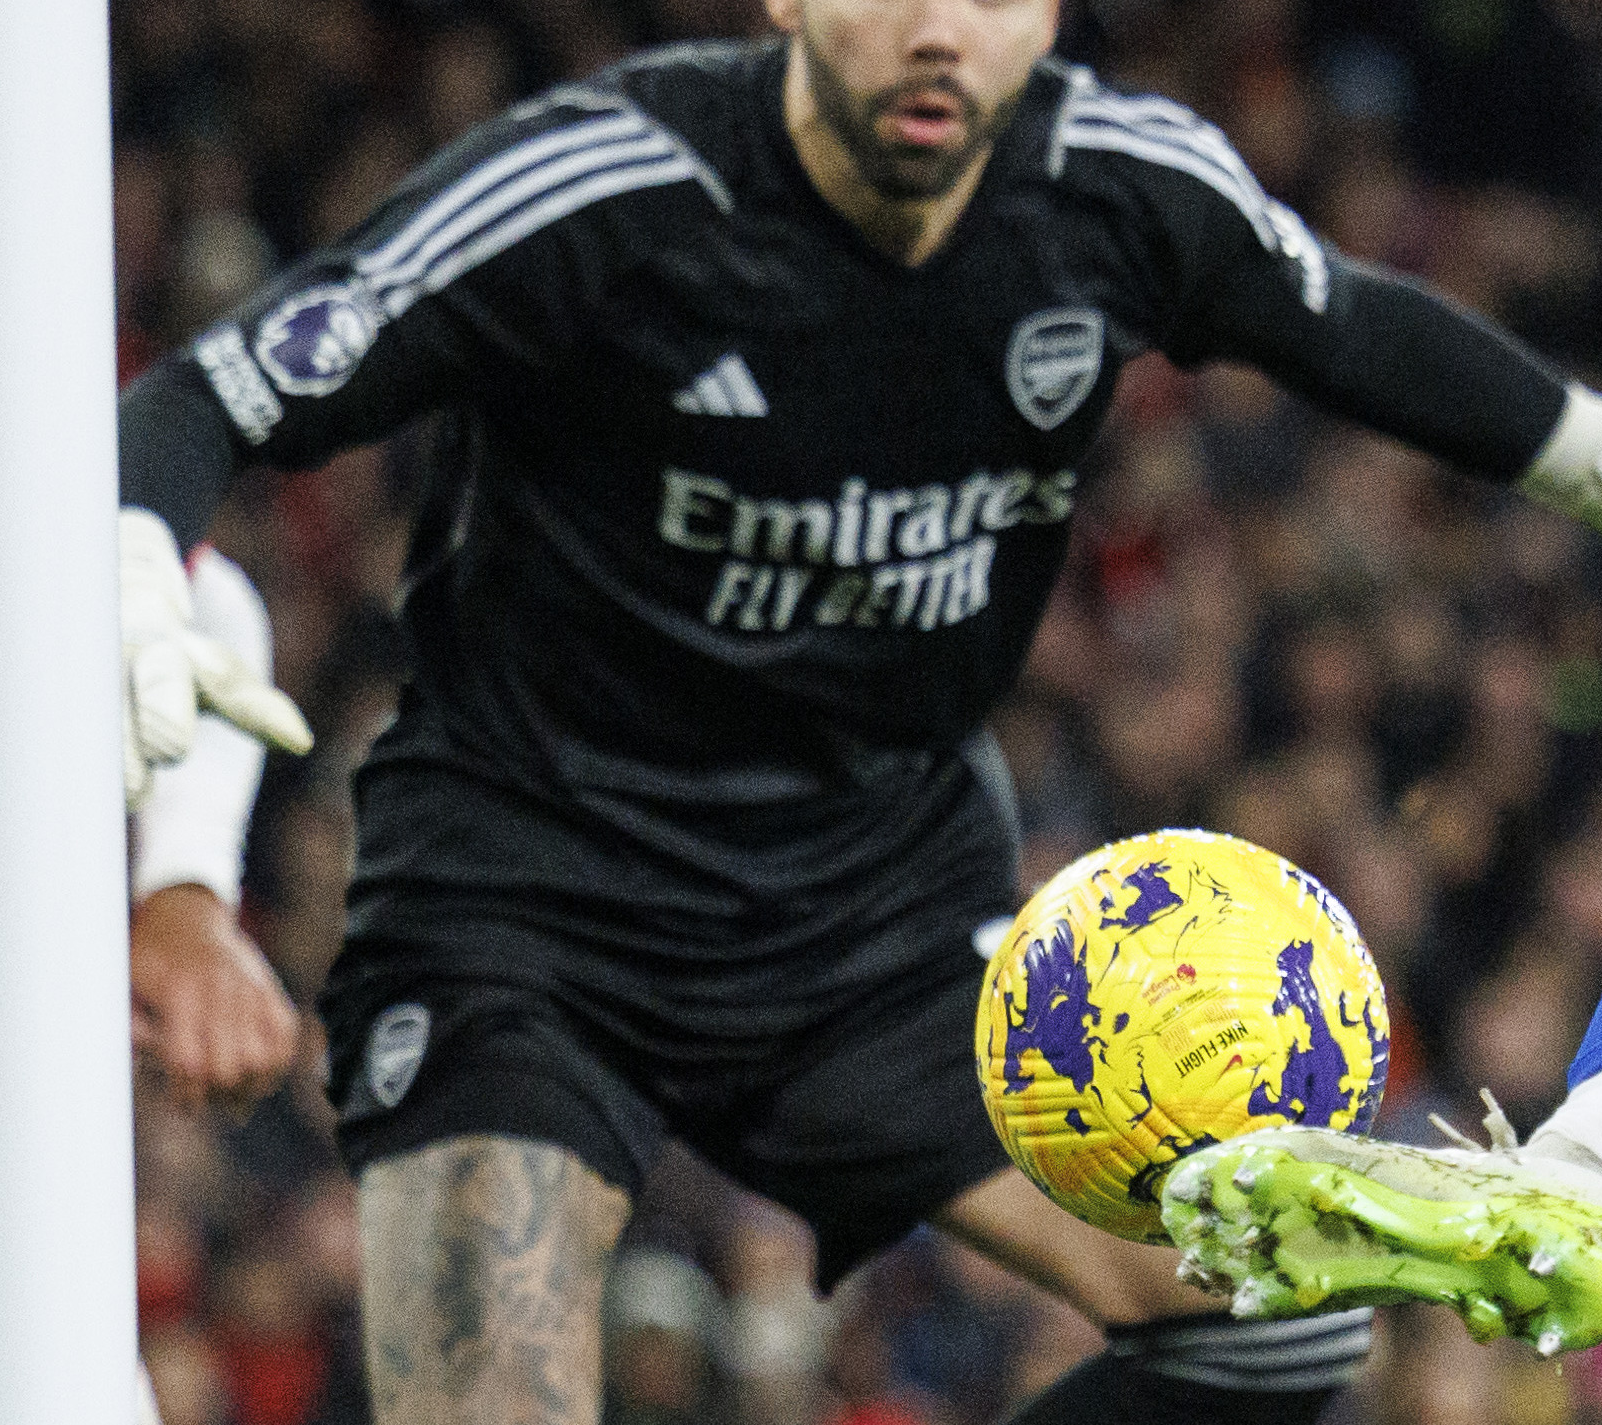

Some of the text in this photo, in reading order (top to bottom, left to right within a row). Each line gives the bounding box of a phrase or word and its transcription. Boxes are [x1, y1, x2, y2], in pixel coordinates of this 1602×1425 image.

[658, 466, 1076, 566] Emirates
[1216, 1020, 1249, 1050] NIKE
[1174, 1040, 1219, 1079] FLIGHT
